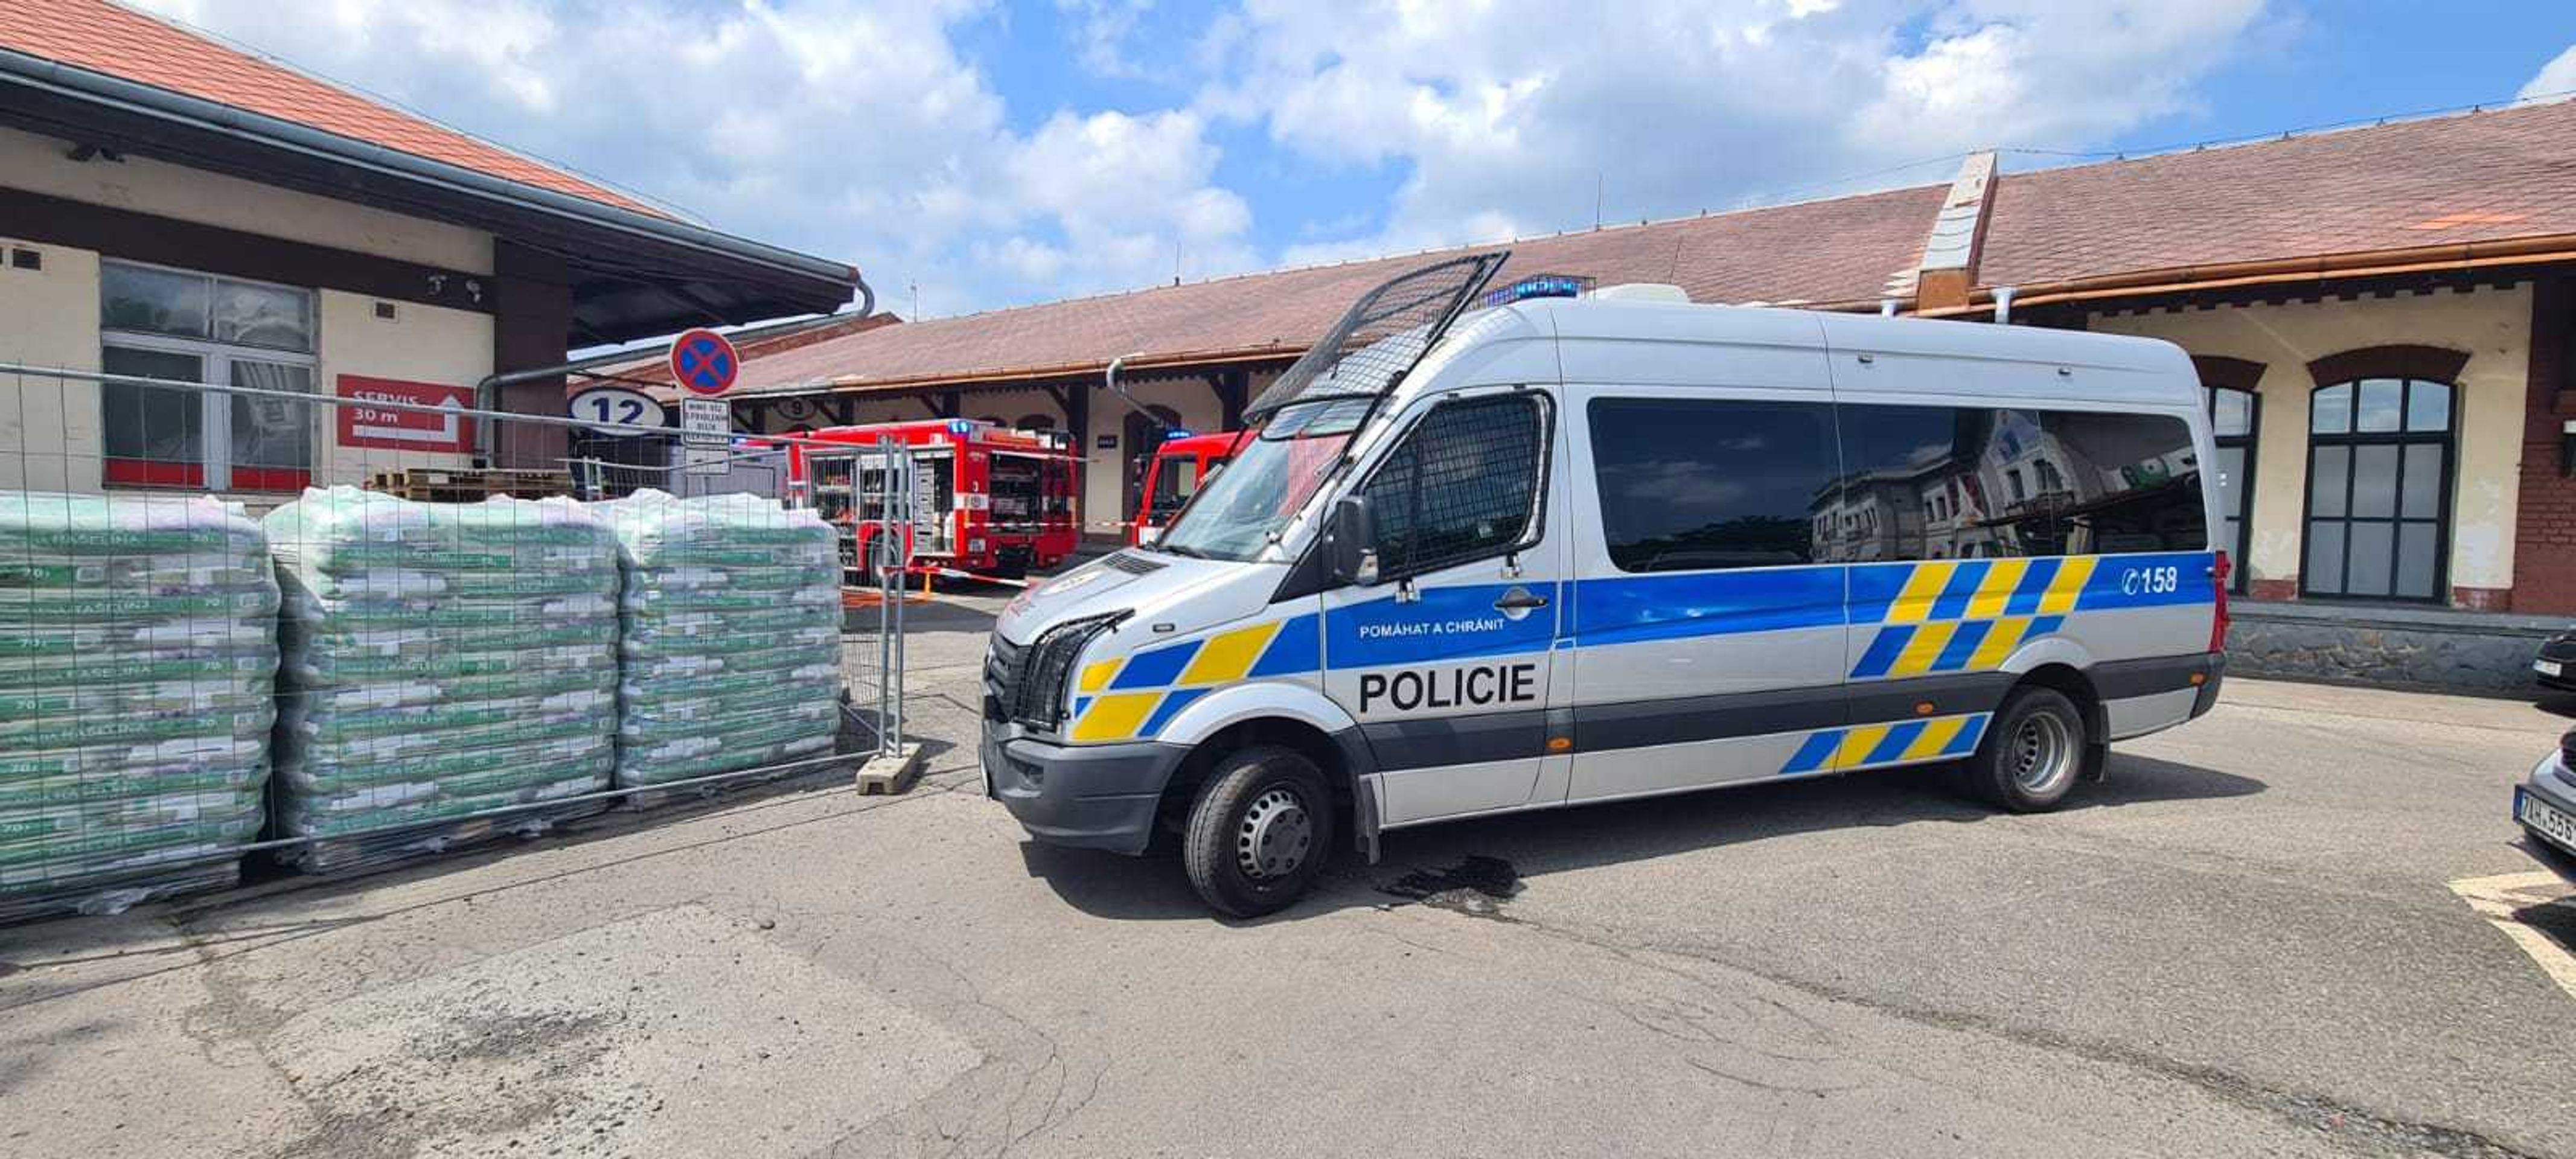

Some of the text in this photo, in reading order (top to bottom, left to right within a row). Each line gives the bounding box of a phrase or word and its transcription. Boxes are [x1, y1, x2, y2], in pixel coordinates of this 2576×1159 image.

[353, 409, 398, 423] 30 m
[592, 397, 644, 423] 12
[2141, 566, 2178, 593] 158
[1360, 618, 1504, 638] POMÁHAT A CHRÁNIT
[1360, 664, 1536, 713] POLICIE
